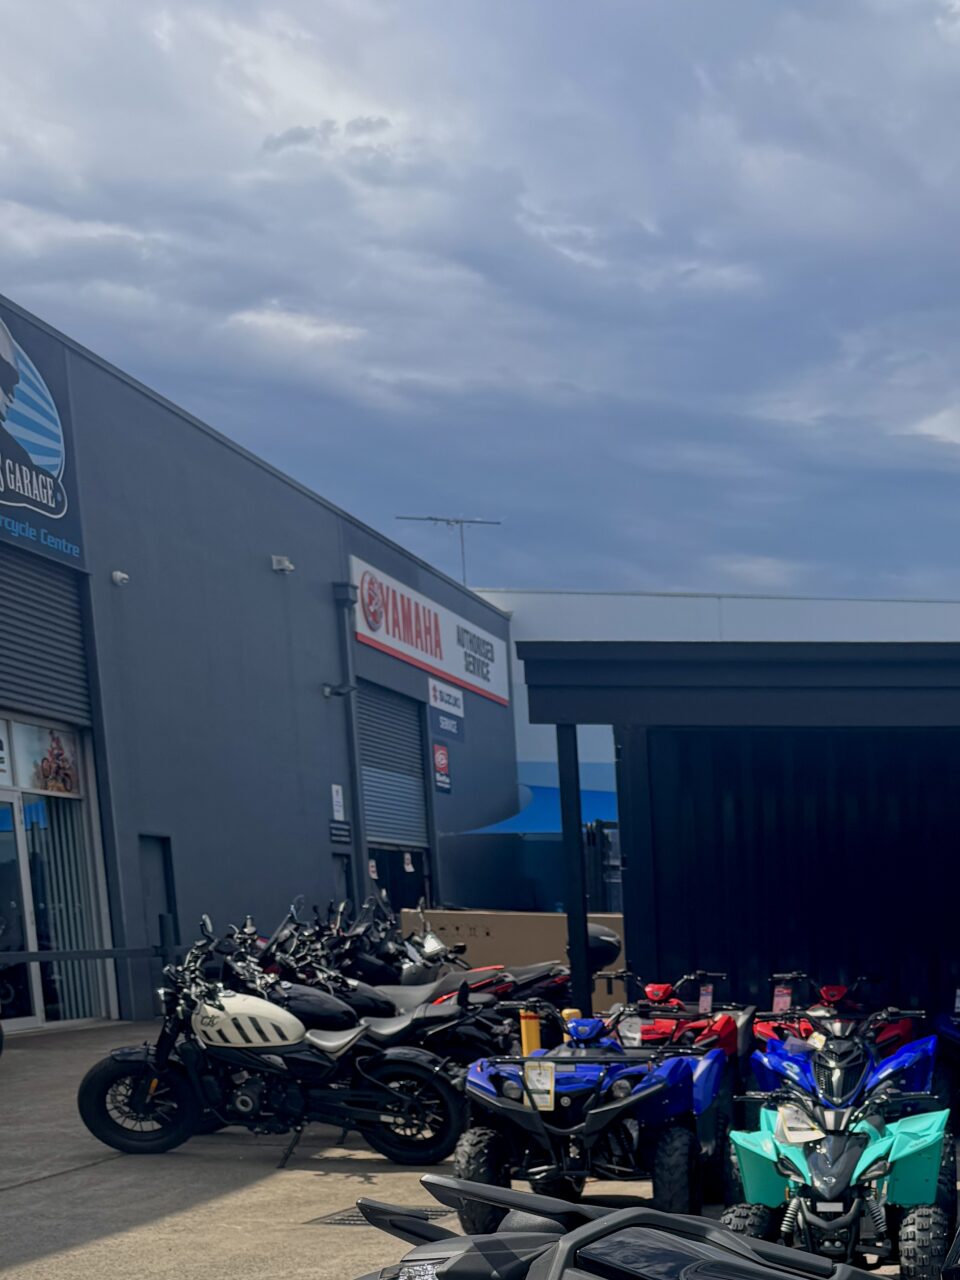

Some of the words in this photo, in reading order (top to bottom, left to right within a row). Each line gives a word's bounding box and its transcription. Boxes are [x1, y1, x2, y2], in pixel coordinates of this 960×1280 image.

[6, 459, 56, 508] GARAGE
[40, 528, 80, 557] Centre
[379, 582, 444, 661] YAMAHA
[464, 651, 491, 683] SERVICE
[438, 689, 461, 710] SUZUKI
